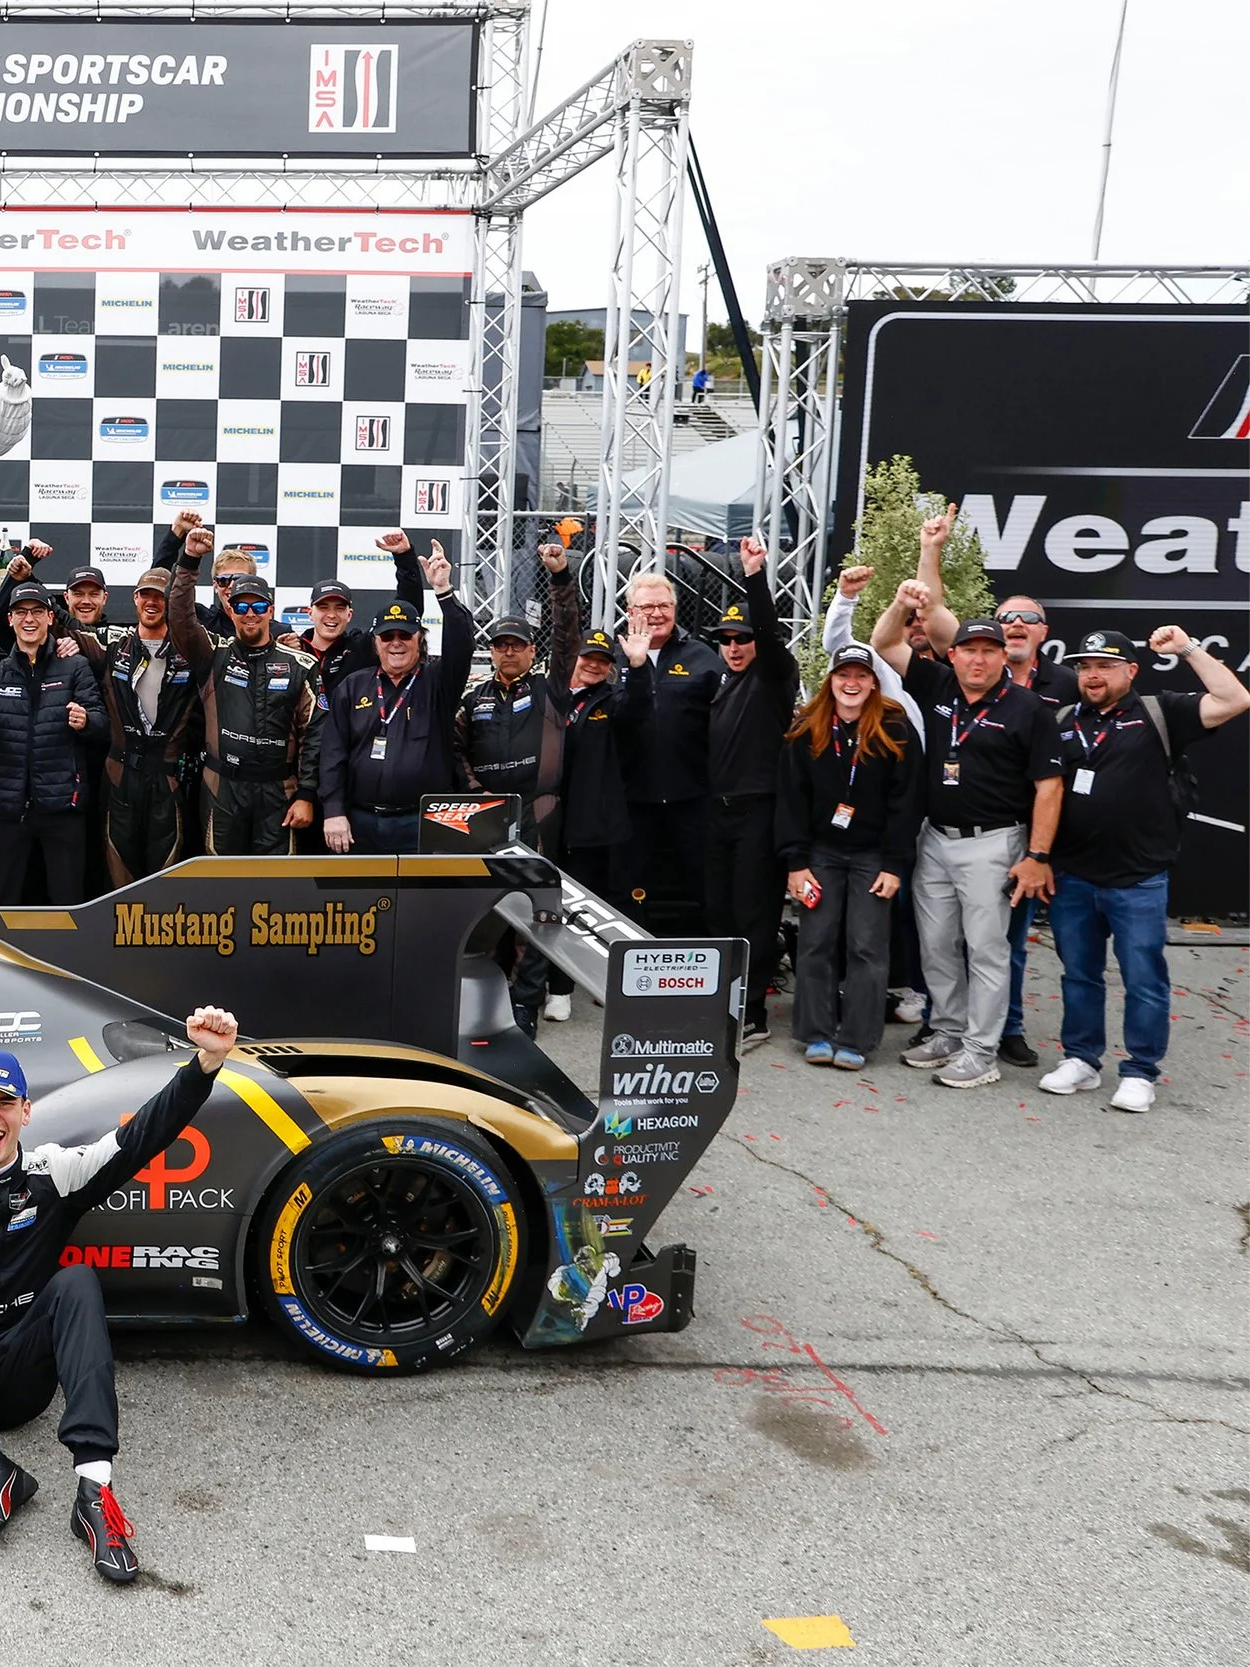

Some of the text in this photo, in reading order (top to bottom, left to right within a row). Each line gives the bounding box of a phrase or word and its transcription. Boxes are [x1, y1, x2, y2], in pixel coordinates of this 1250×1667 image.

[2, 54, 228, 86] SPORTSCAR
[316, 50, 337, 128] IMSA
[221, 728, 286, 747] PORSCHE
[427, 803, 480, 813] SPEED
[433, 812, 474, 822] SEAT
[114, 903, 236, 956] Mustang
[658, 978, 705, 988] BOSCH
[634, 1039, 714, 1055] Multimatic
[613, 1063, 695, 1096] wiha
[637, 1115, 699, 1130] HEXAGON
[613, 1141, 680, 1154] PRODUCTIVITY
[419, 1141, 502, 1196] MICHELIN
[613, 1151, 679, 1166] QUALITY INC
[169, 1188, 235, 1209] PACK
[277, 1230, 288, 1259] SPORT
[285, 1303, 364, 1365] MICHELIN
